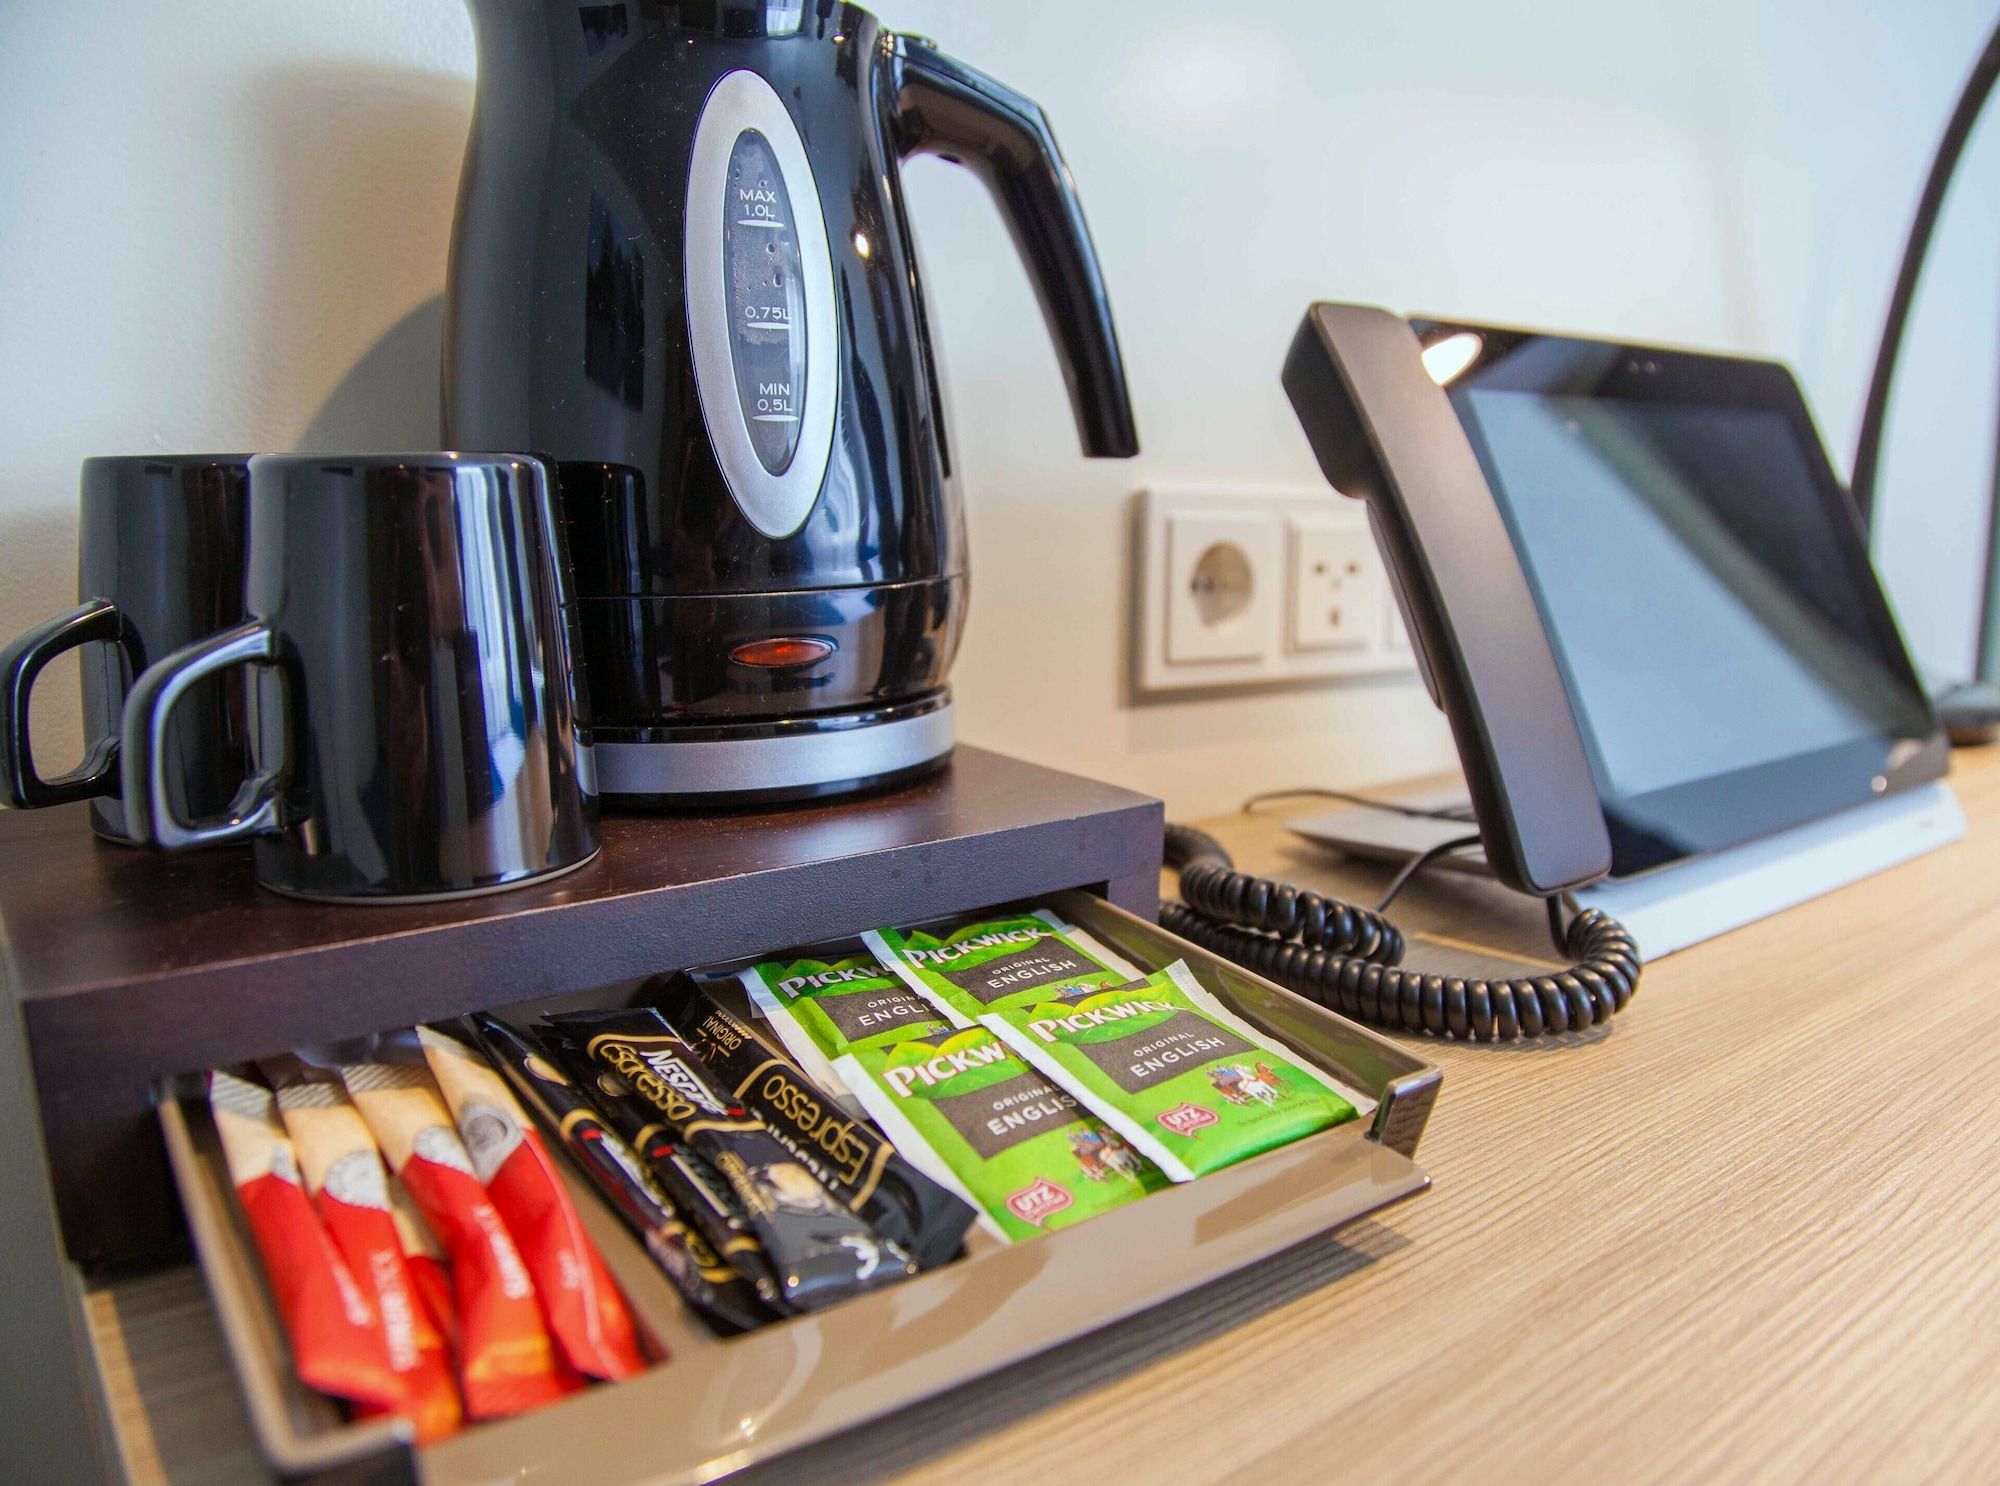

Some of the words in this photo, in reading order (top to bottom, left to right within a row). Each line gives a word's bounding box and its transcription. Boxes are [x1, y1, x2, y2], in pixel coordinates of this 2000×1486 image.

[740, 189, 777, 203] MAX
[744, 204, 775, 217] 1.0L
[745, 306, 791, 320] 0.75L
[759, 383, 790, 396] MIN
[757, 399, 793, 413] 0.5L
[901, 927, 1051, 969] PICKWICK
[986, 960, 1077, 989] ENGLISH
[991, 957, 1050, 976] ORIGINAL
[777, 965, 890, 1000] PICKW
[858, 1003, 930, 1026] ENGLI
[867, 995, 917, 1008] ORIGIN
[1026, 1000, 1177, 1044] PICKWICK
[1132, 1031, 1196, 1057] ORIGINAL
[882, 1041, 1006, 1099] PICKW
[1129, 1037, 1225, 1079] ENGLISH
[639, 1049, 729, 1115] NESC
[986, 1095, 1077, 1136] ENGLIS
[1166, 1107, 1200, 1126] UTZ
[763, 1075, 871, 1185] Espresso
